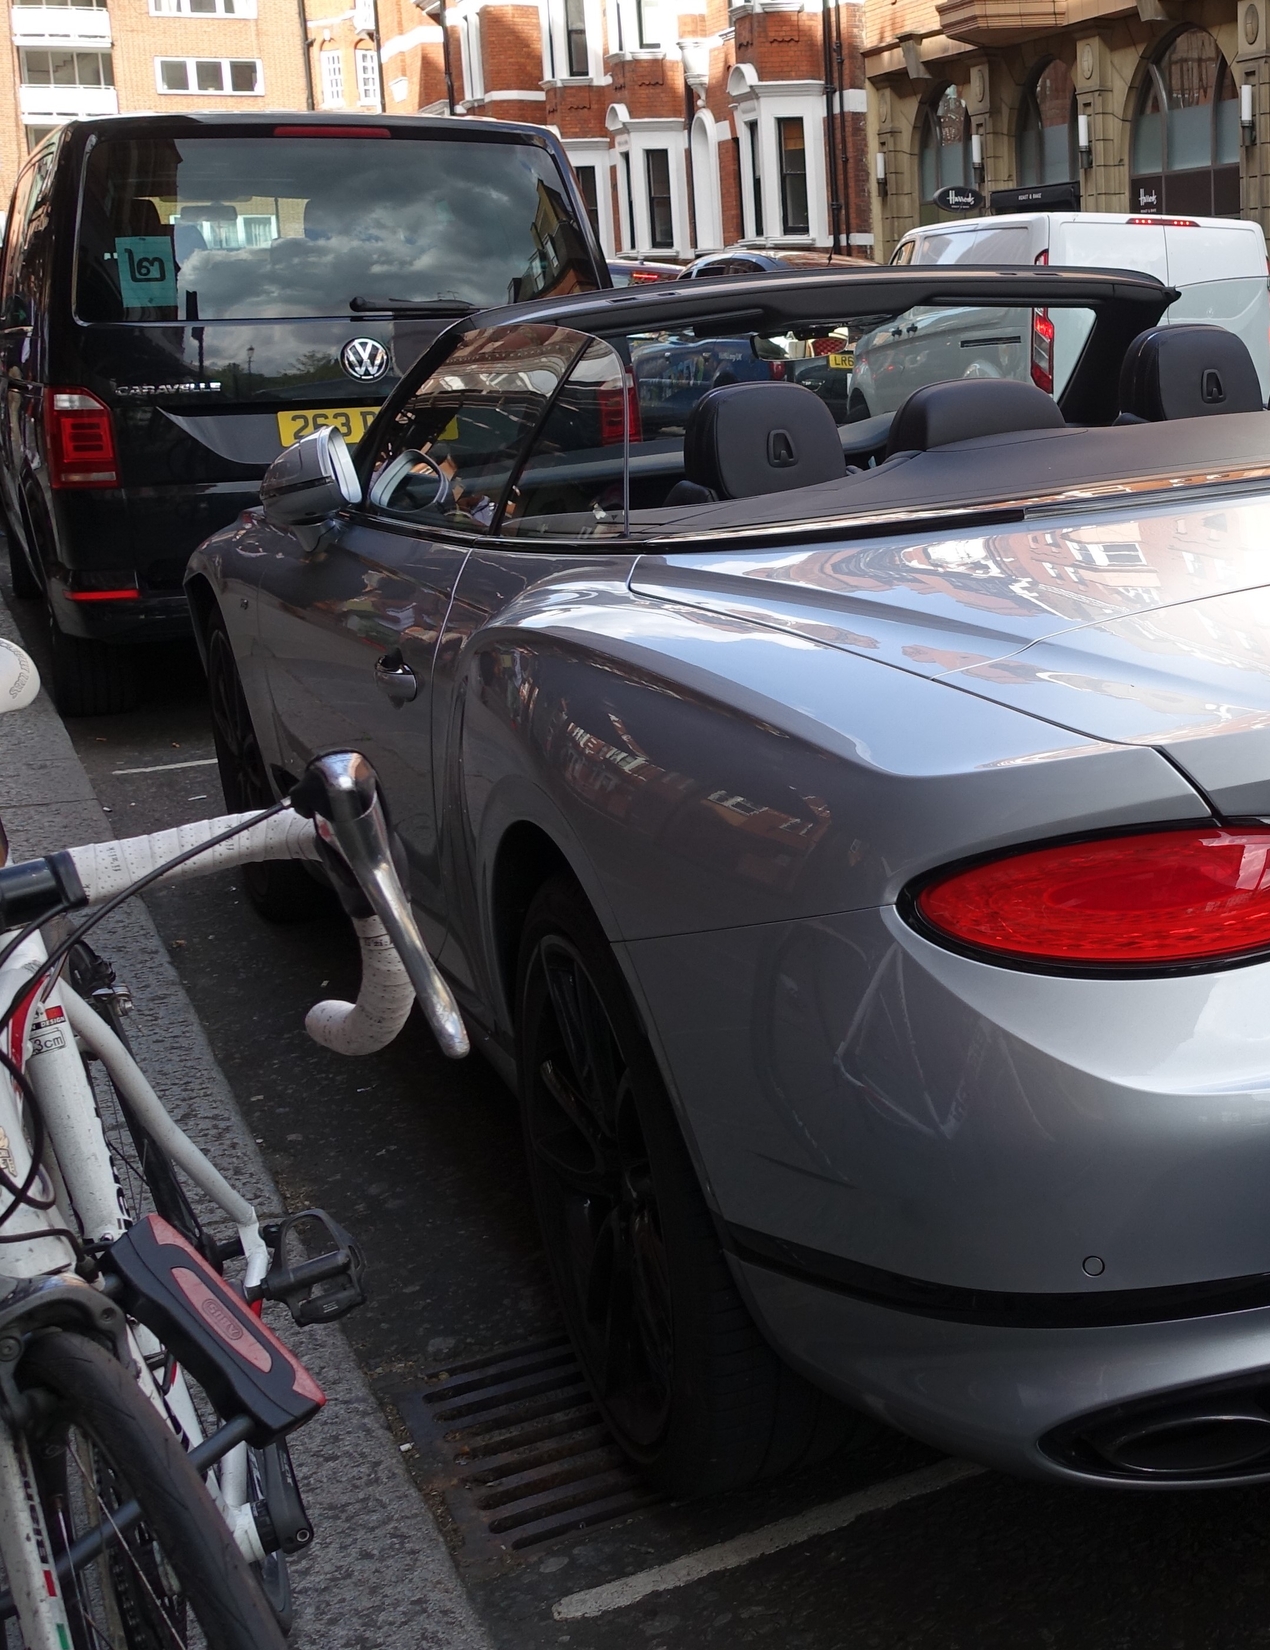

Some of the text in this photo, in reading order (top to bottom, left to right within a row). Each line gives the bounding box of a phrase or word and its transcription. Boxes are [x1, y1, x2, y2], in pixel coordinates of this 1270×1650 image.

[946, 189, 975, 205] Harrods
[833, 355, 854, 366] LR6
[115, 381, 222, 397] CARAVELLE
[32, 1036, 63, 1054] 3cm
[206, 1300, 240, 1337] ABUS
